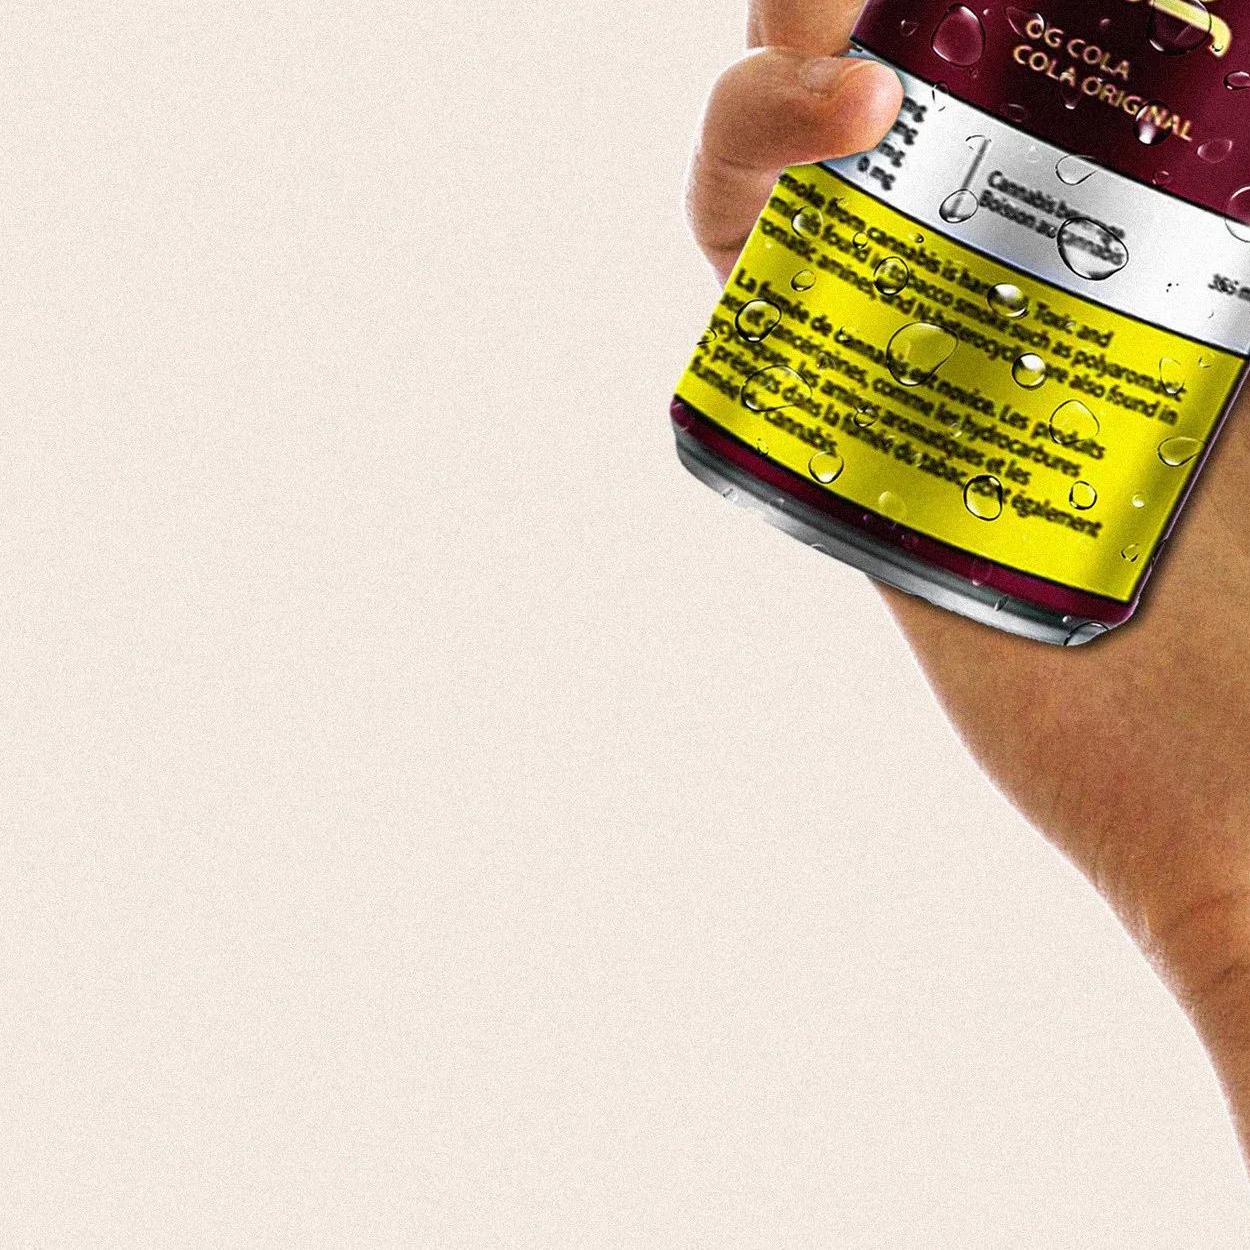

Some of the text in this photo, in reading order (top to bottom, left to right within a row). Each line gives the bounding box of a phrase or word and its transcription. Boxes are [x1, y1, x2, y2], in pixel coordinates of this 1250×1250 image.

[1013, 45, 1077, 87] COLA
[1025, 19, 1130, 81] OG COLA
[979, 189, 1037, 229] Boisson
[987, 170, 1056, 214] Cannabis
[826, 197, 867, 232] from
[867, 227, 941, 273] cannabis
[940, 260, 958, 282] is
[1076, 324, 1115, 348] and
[735, 269, 757, 294] La
[811, 314, 833, 337] de
[999, 403, 1029, 431] Les
[953, 297, 1010, 333] smoke
[1009, 323, 1050, 349] such
[1052, 340, 1072, 359] as
[822, 402, 841, 427] la
[872, 378, 935, 417] comme
[960, 413, 1081, 478] hydrocarbures
[1069, 373, 1106, 398] also
[1105, 385, 1161, 418] found
[1158, 404, 1179, 426] in
[881, 410, 985, 467] aromatiques
[985, 456, 1006, 475] et
[1004, 459, 1032, 485] les
